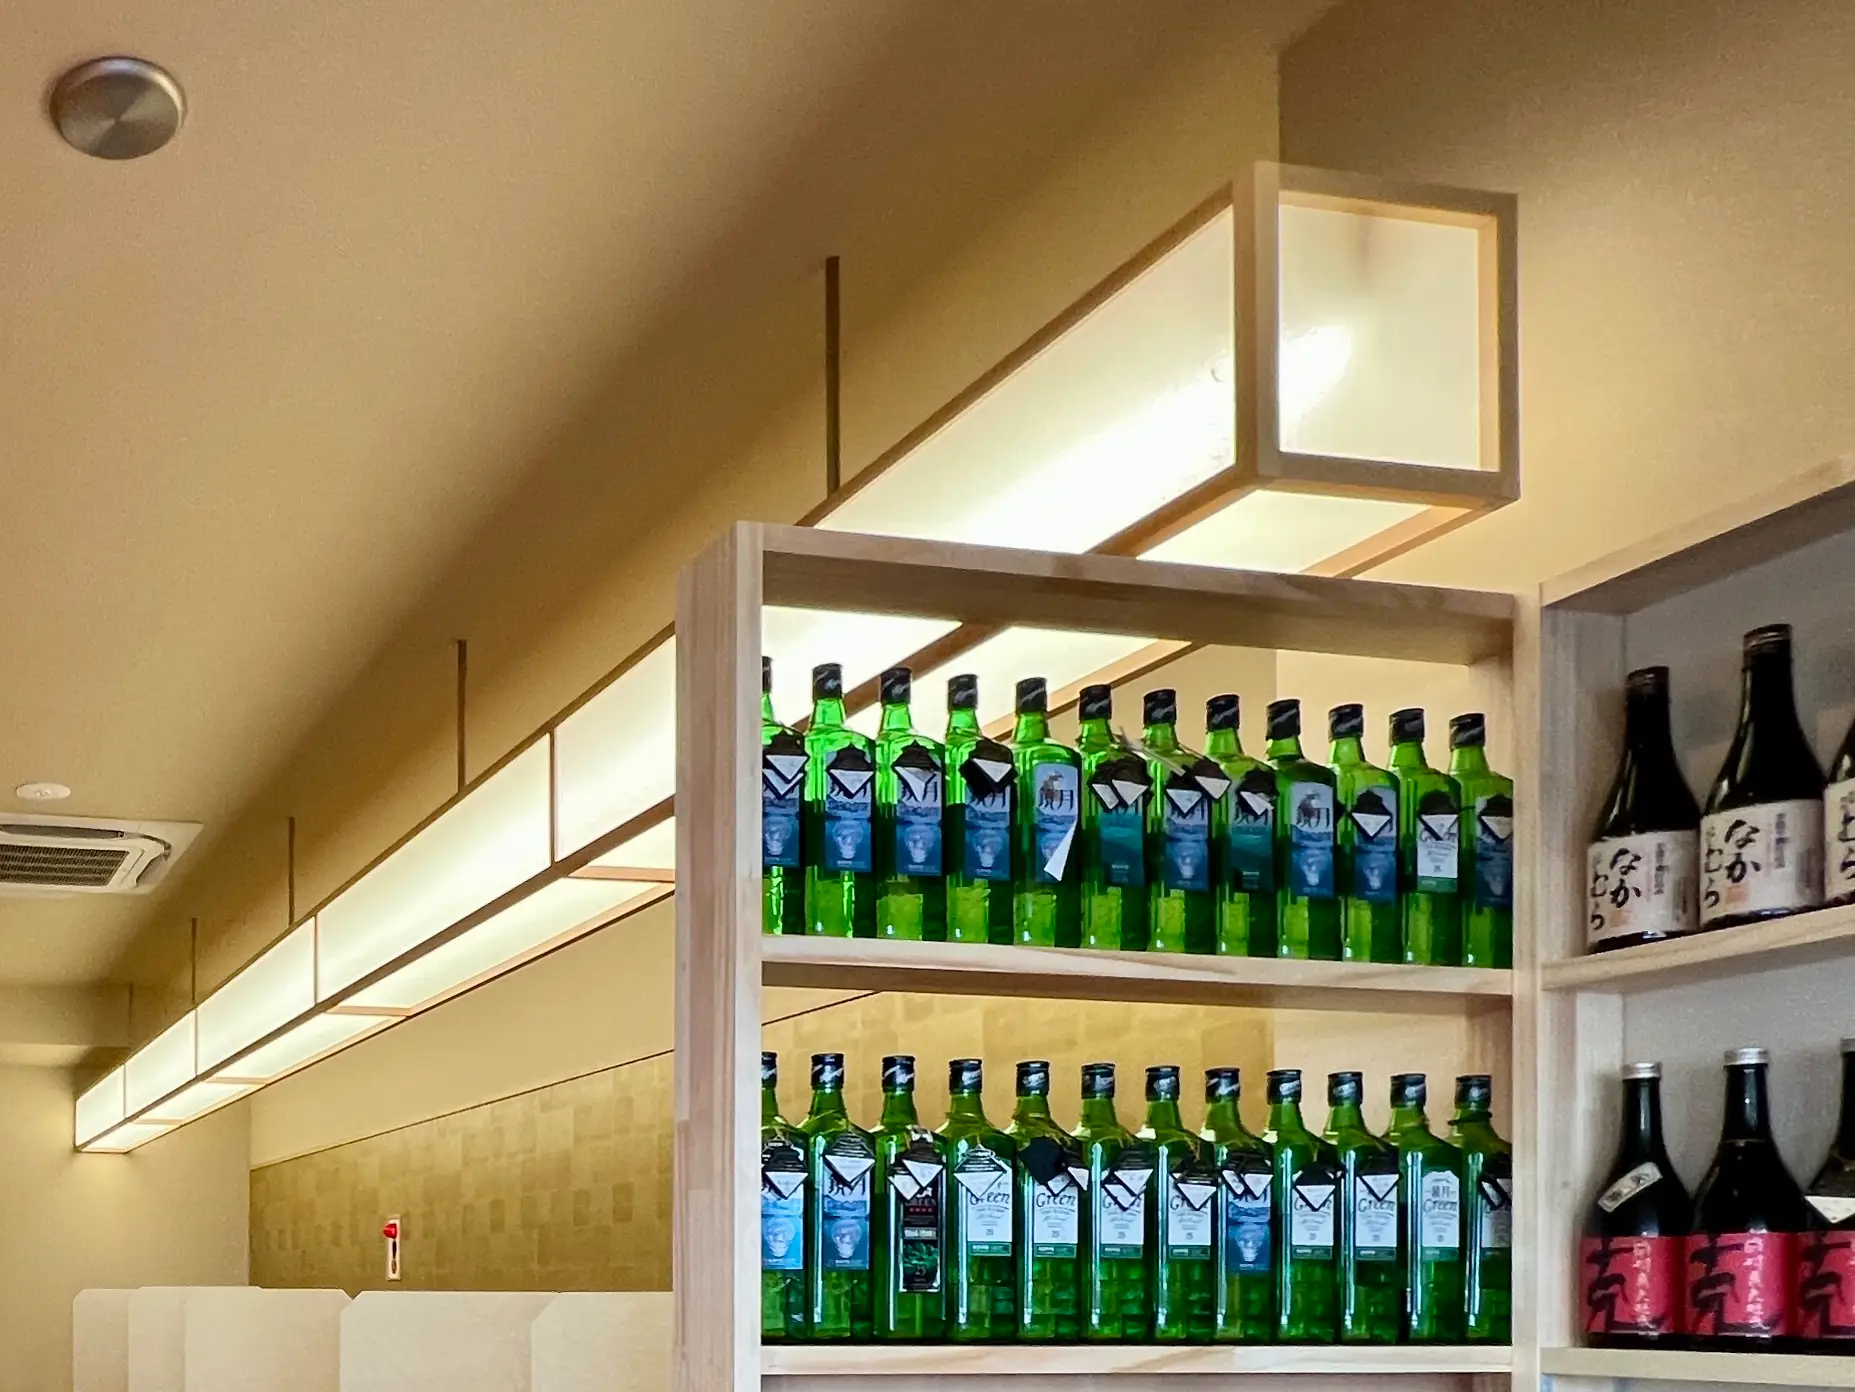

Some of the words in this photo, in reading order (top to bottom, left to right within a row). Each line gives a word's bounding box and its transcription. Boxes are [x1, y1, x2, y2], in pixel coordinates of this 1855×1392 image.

[1724, 819, 1761, 883] なか
[1610, 847, 1642, 909] なか
[1035, 1192, 1076, 1208] Green
[1358, 1197, 1395, 1213] Green
[1423, 1198, 1458, 1213] Green
